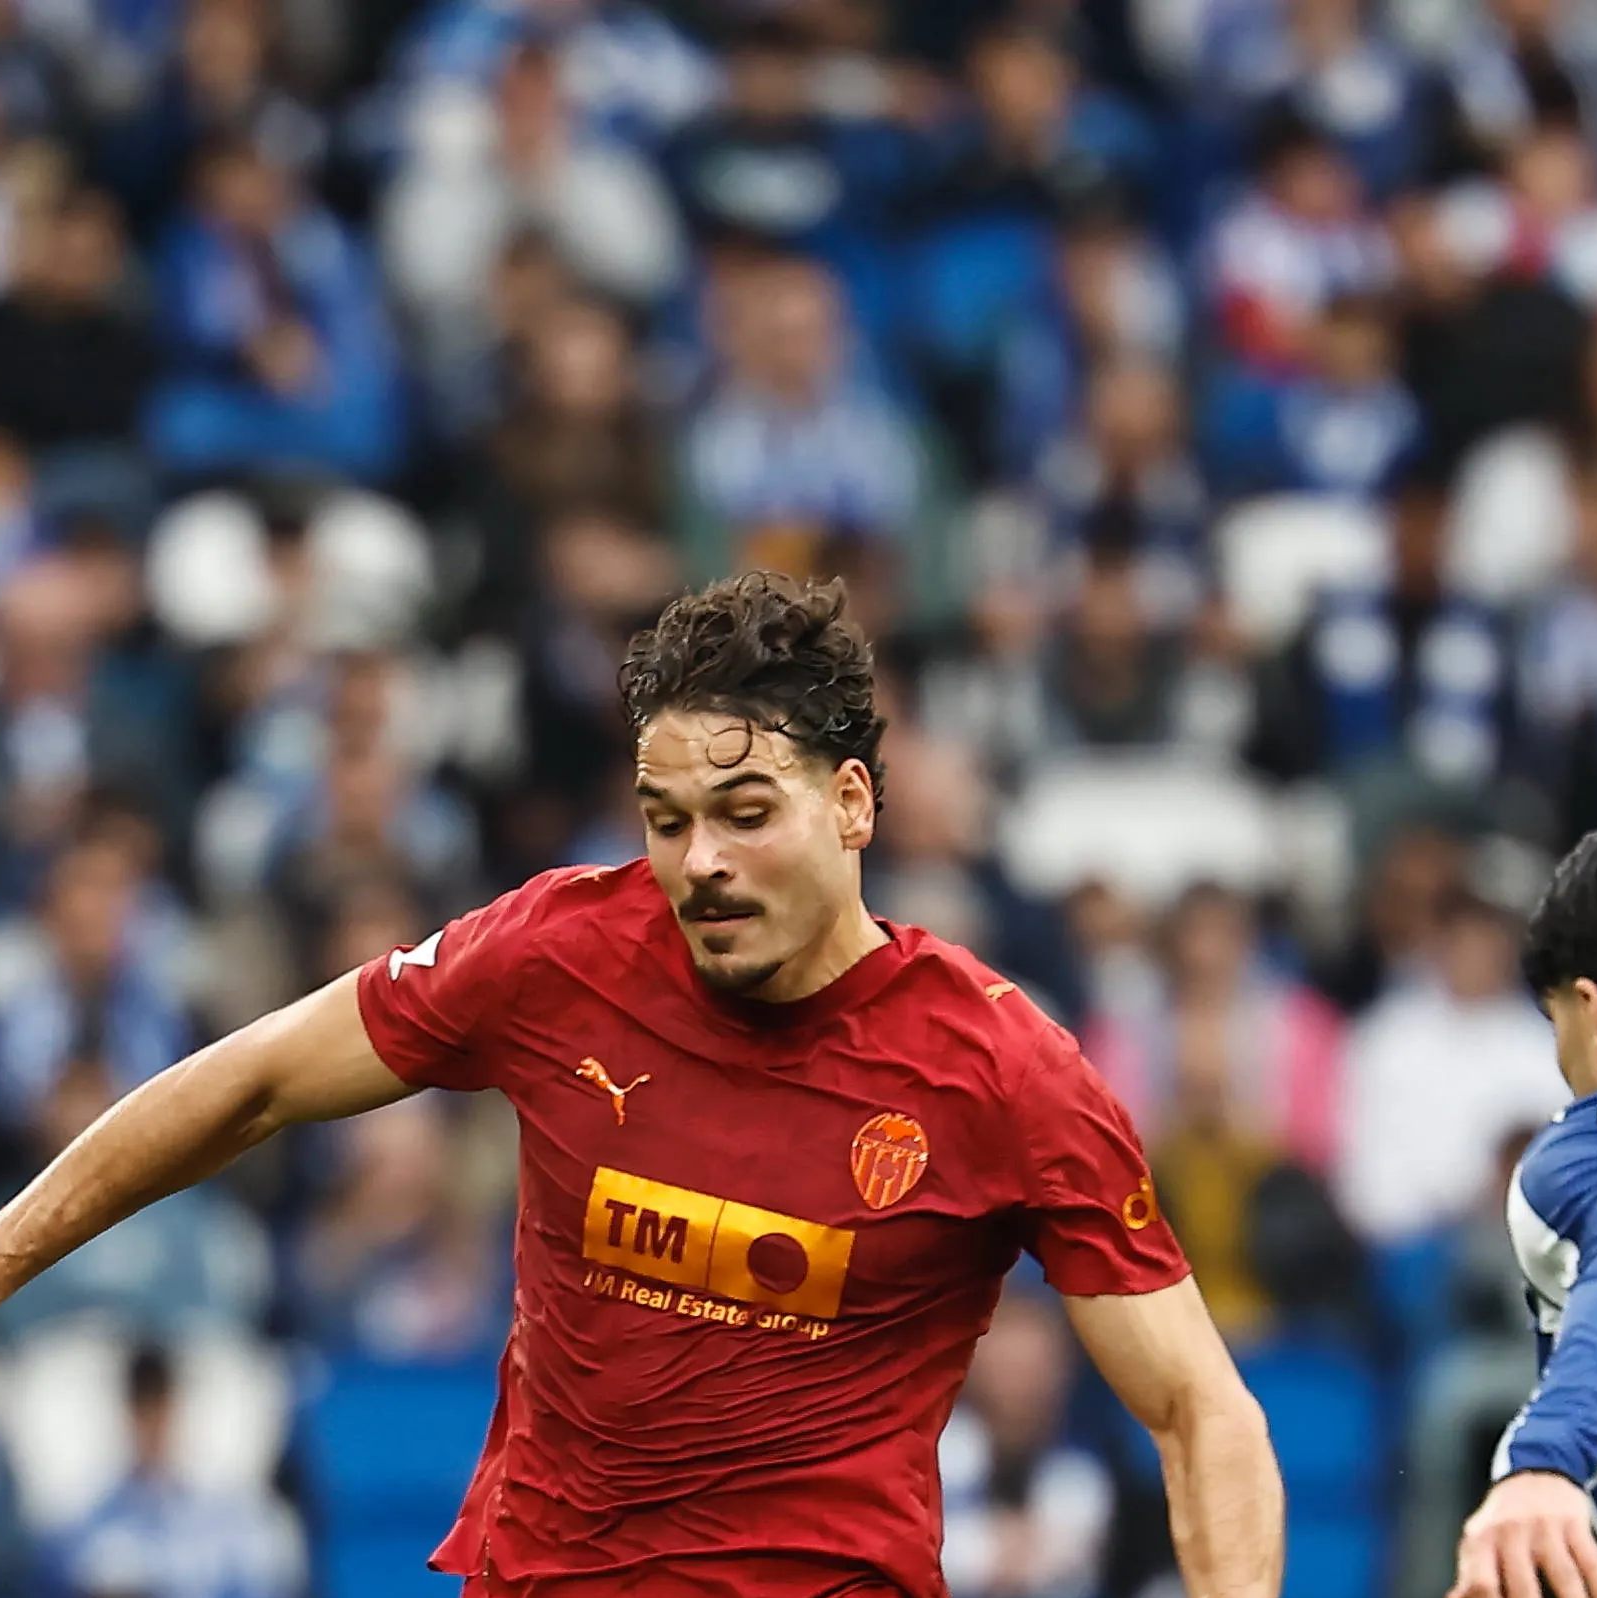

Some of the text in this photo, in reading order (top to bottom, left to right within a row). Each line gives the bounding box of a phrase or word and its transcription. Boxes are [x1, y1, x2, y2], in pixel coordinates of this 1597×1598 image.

[604, 1198, 690, 1265] TM
[619, 1278, 673, 1311] Real
[676, 1292, 750, 1327] Estate
